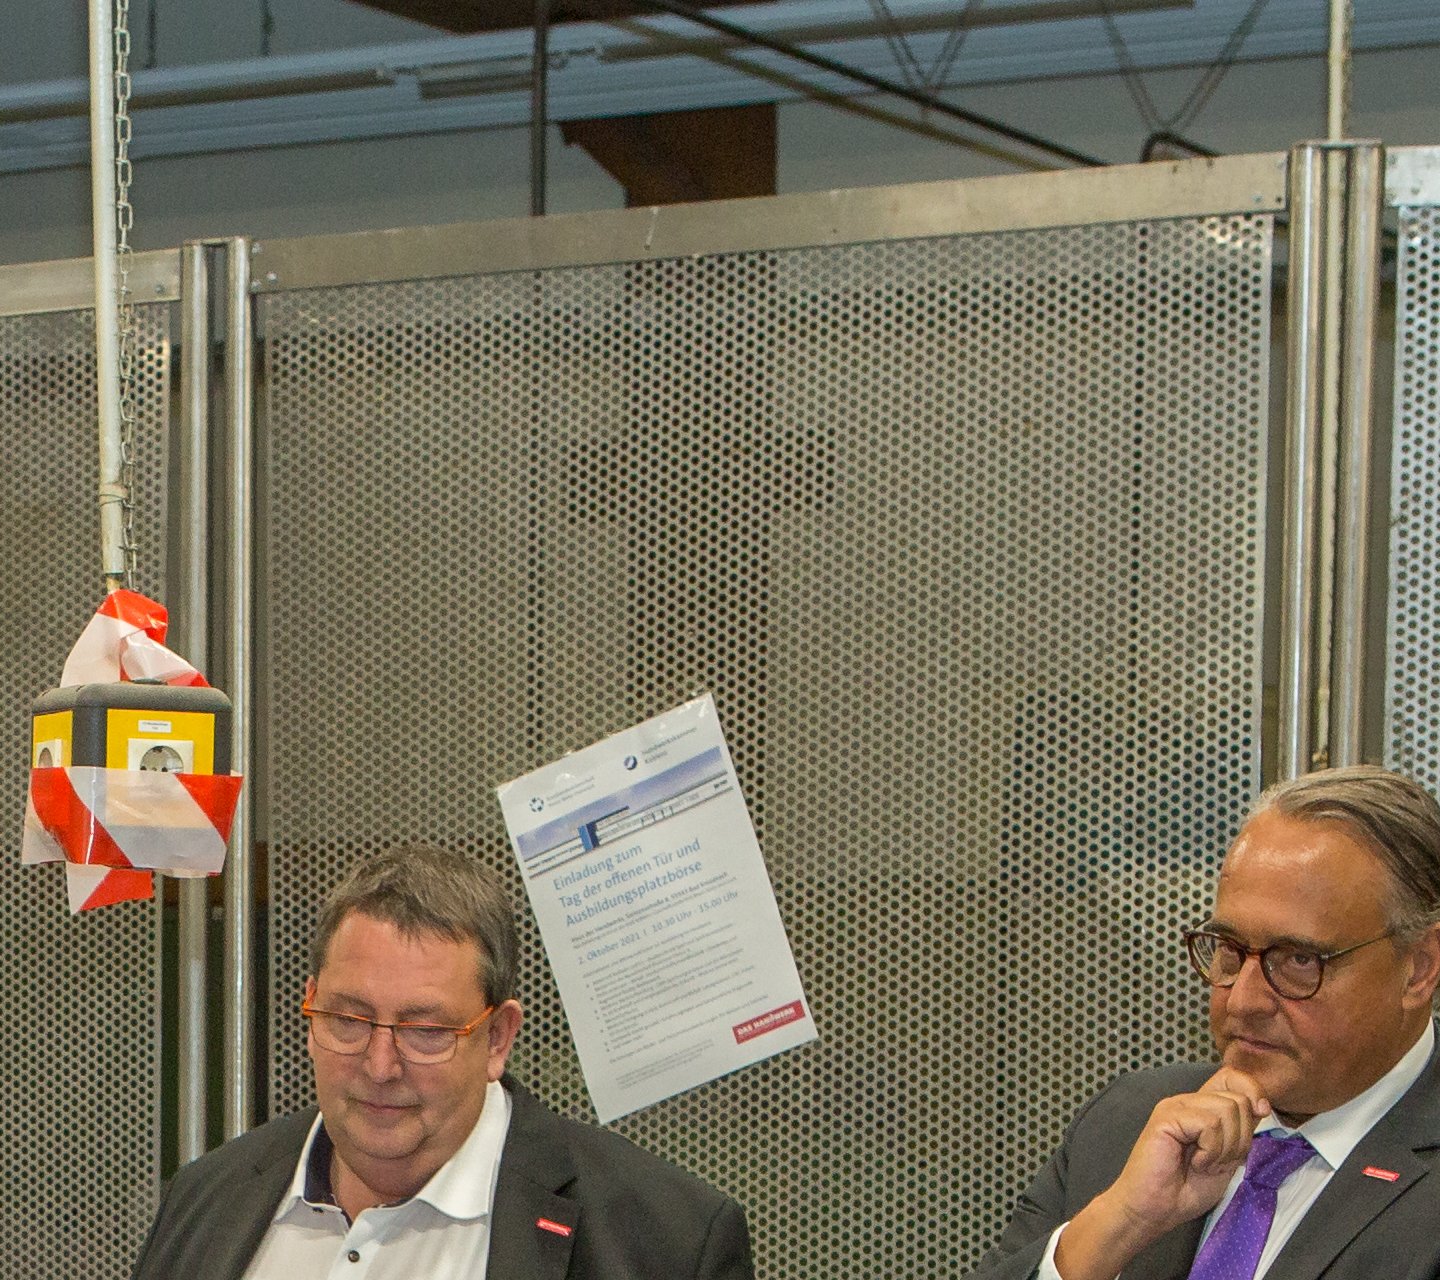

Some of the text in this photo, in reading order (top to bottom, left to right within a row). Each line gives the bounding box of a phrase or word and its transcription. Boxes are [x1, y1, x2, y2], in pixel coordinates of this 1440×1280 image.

[552, 854, 614, 892] Einladung
[614, 843, 642, 863] zum
[558, 837, 701, 911] Tag der offenen Tür und
[563, 857, 703, 929] Ausbildungsplatzbörse
